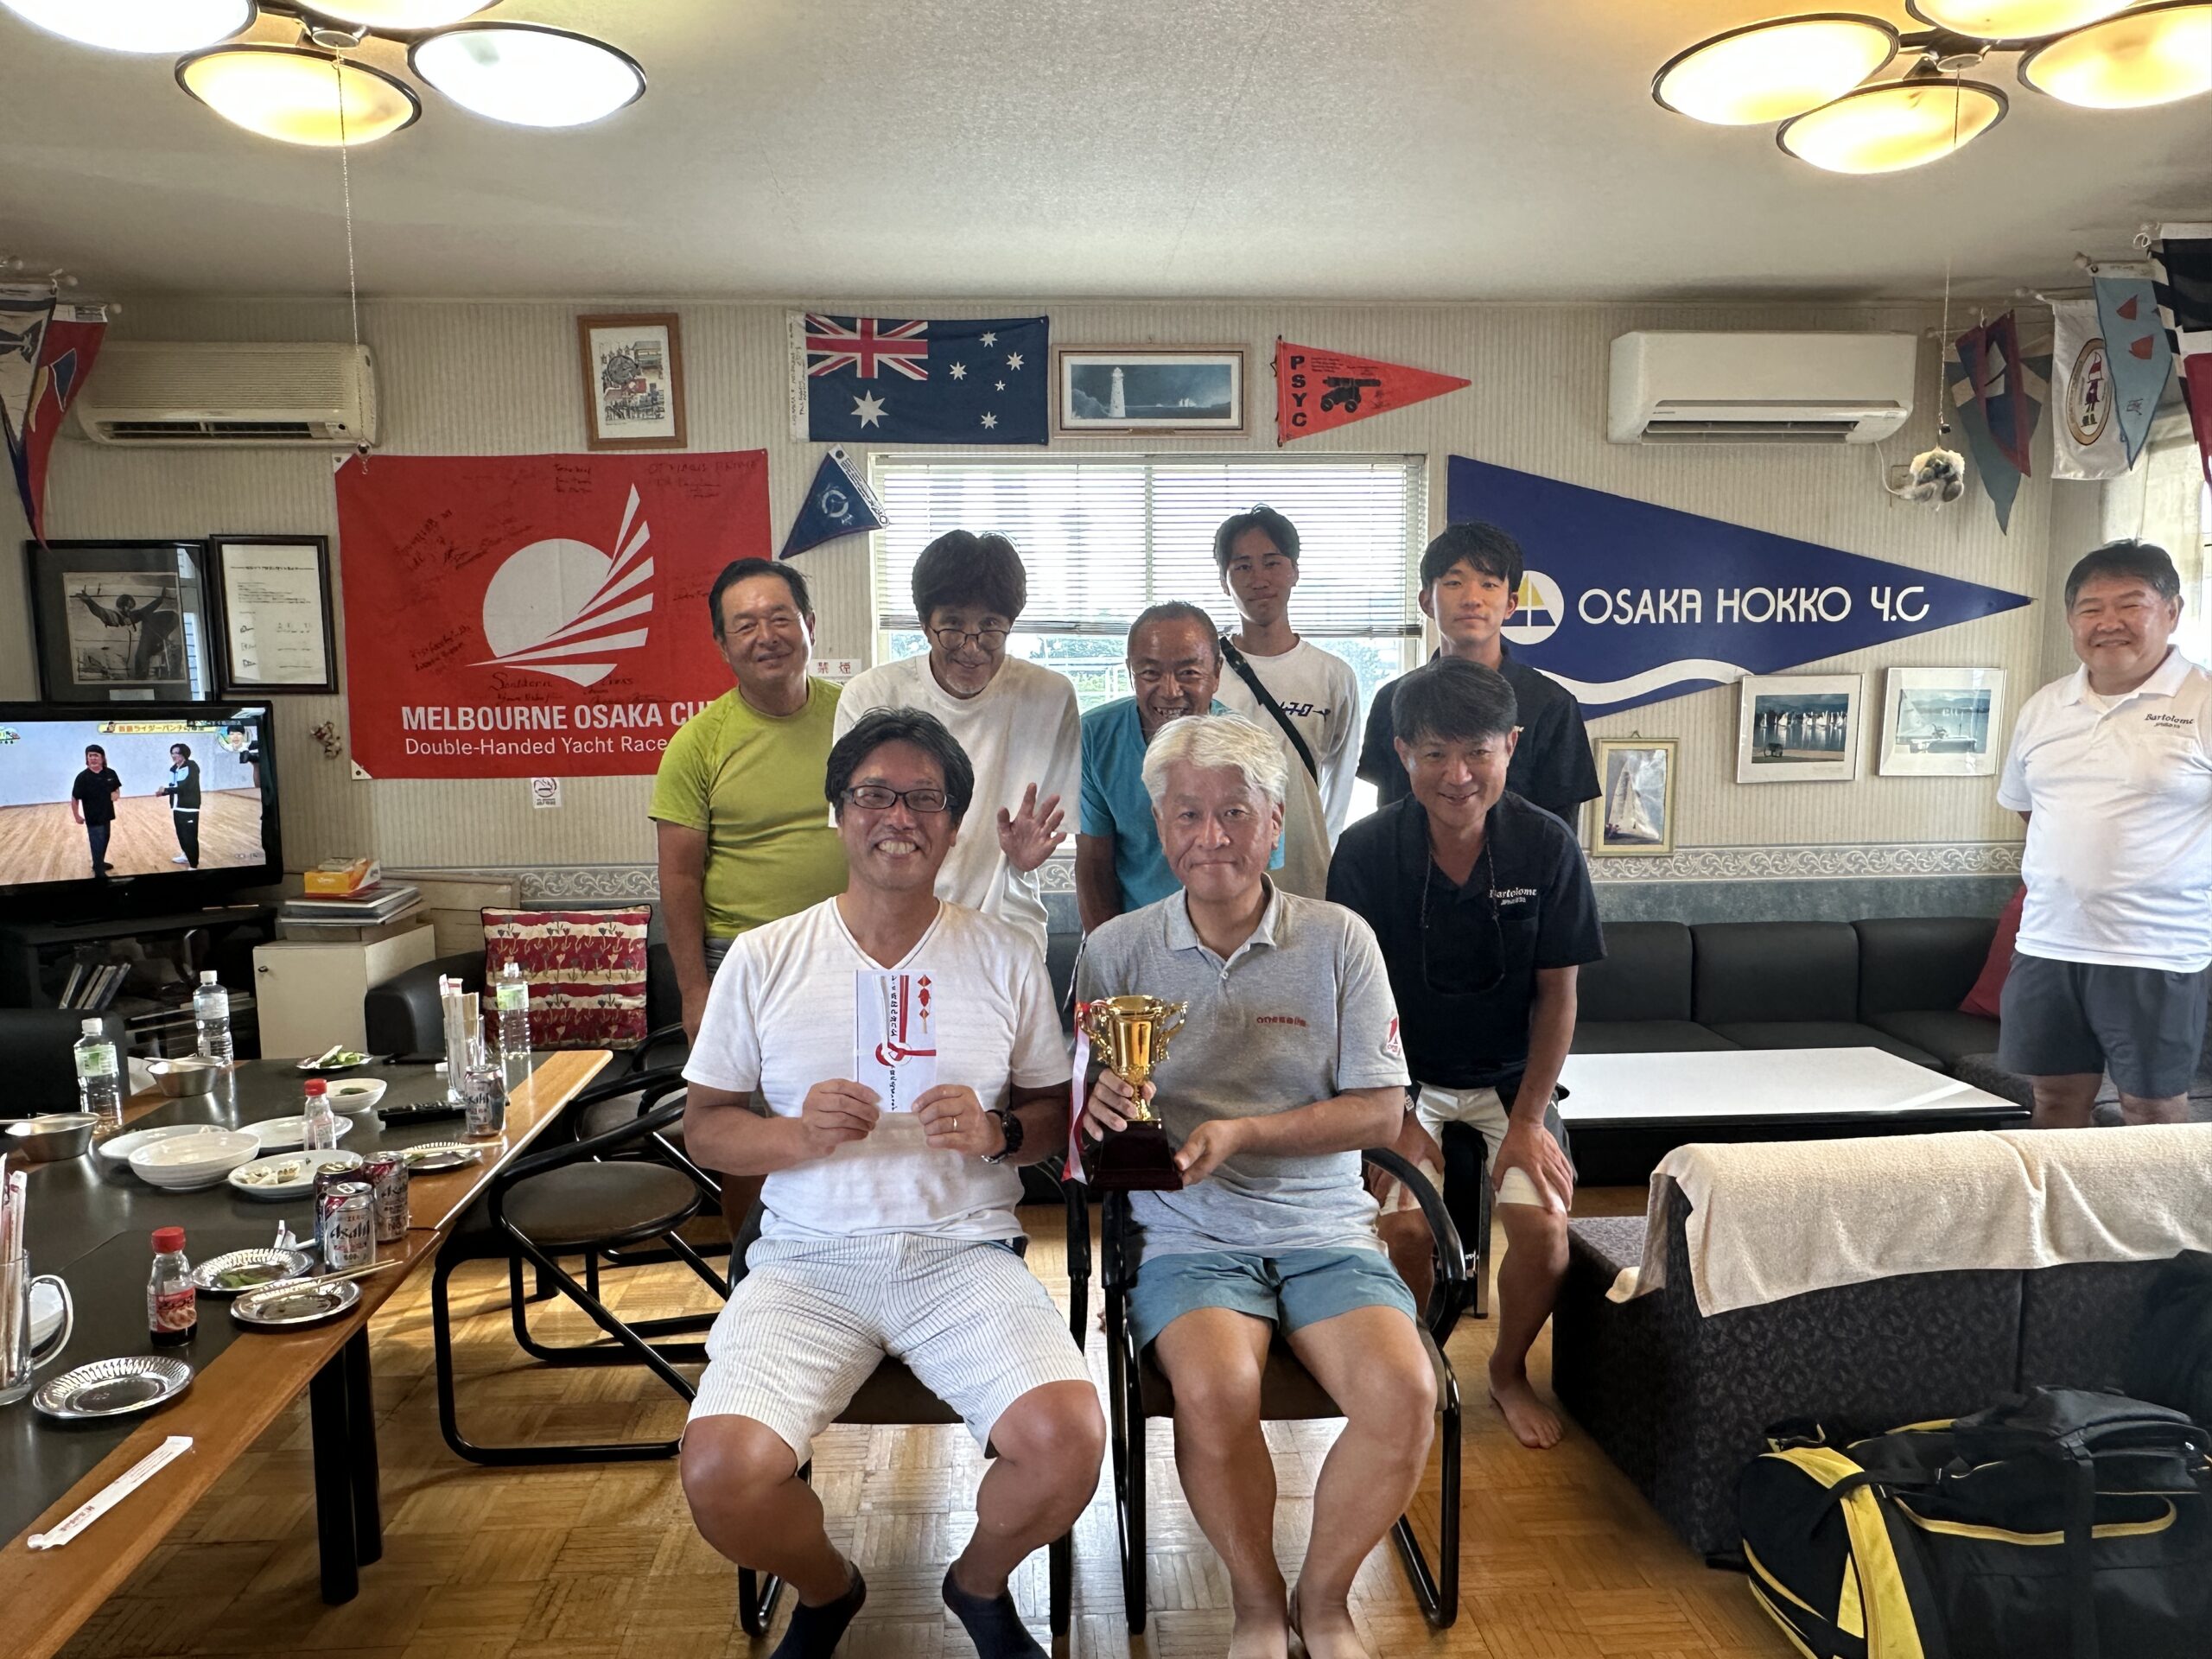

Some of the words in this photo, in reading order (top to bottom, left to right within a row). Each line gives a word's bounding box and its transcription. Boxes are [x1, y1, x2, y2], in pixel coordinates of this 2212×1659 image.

[1290, 355, 1307, 427] PSYC
[1578, 588, 1702, 625] OSAKA
[1717, 586, 1853, 623] HOKKO
[402, 706, 567, 732] MELBOURNE
[575, 703, 664, 729] OSAKA
[671, 701, 715, 726] CU
[405, 738, 556, 756] Double-Handed
[562, 736, 614, 754] Yacht
[621, 736, 668, 753] Race
[330, 1219, 370, 1239] Asahi
